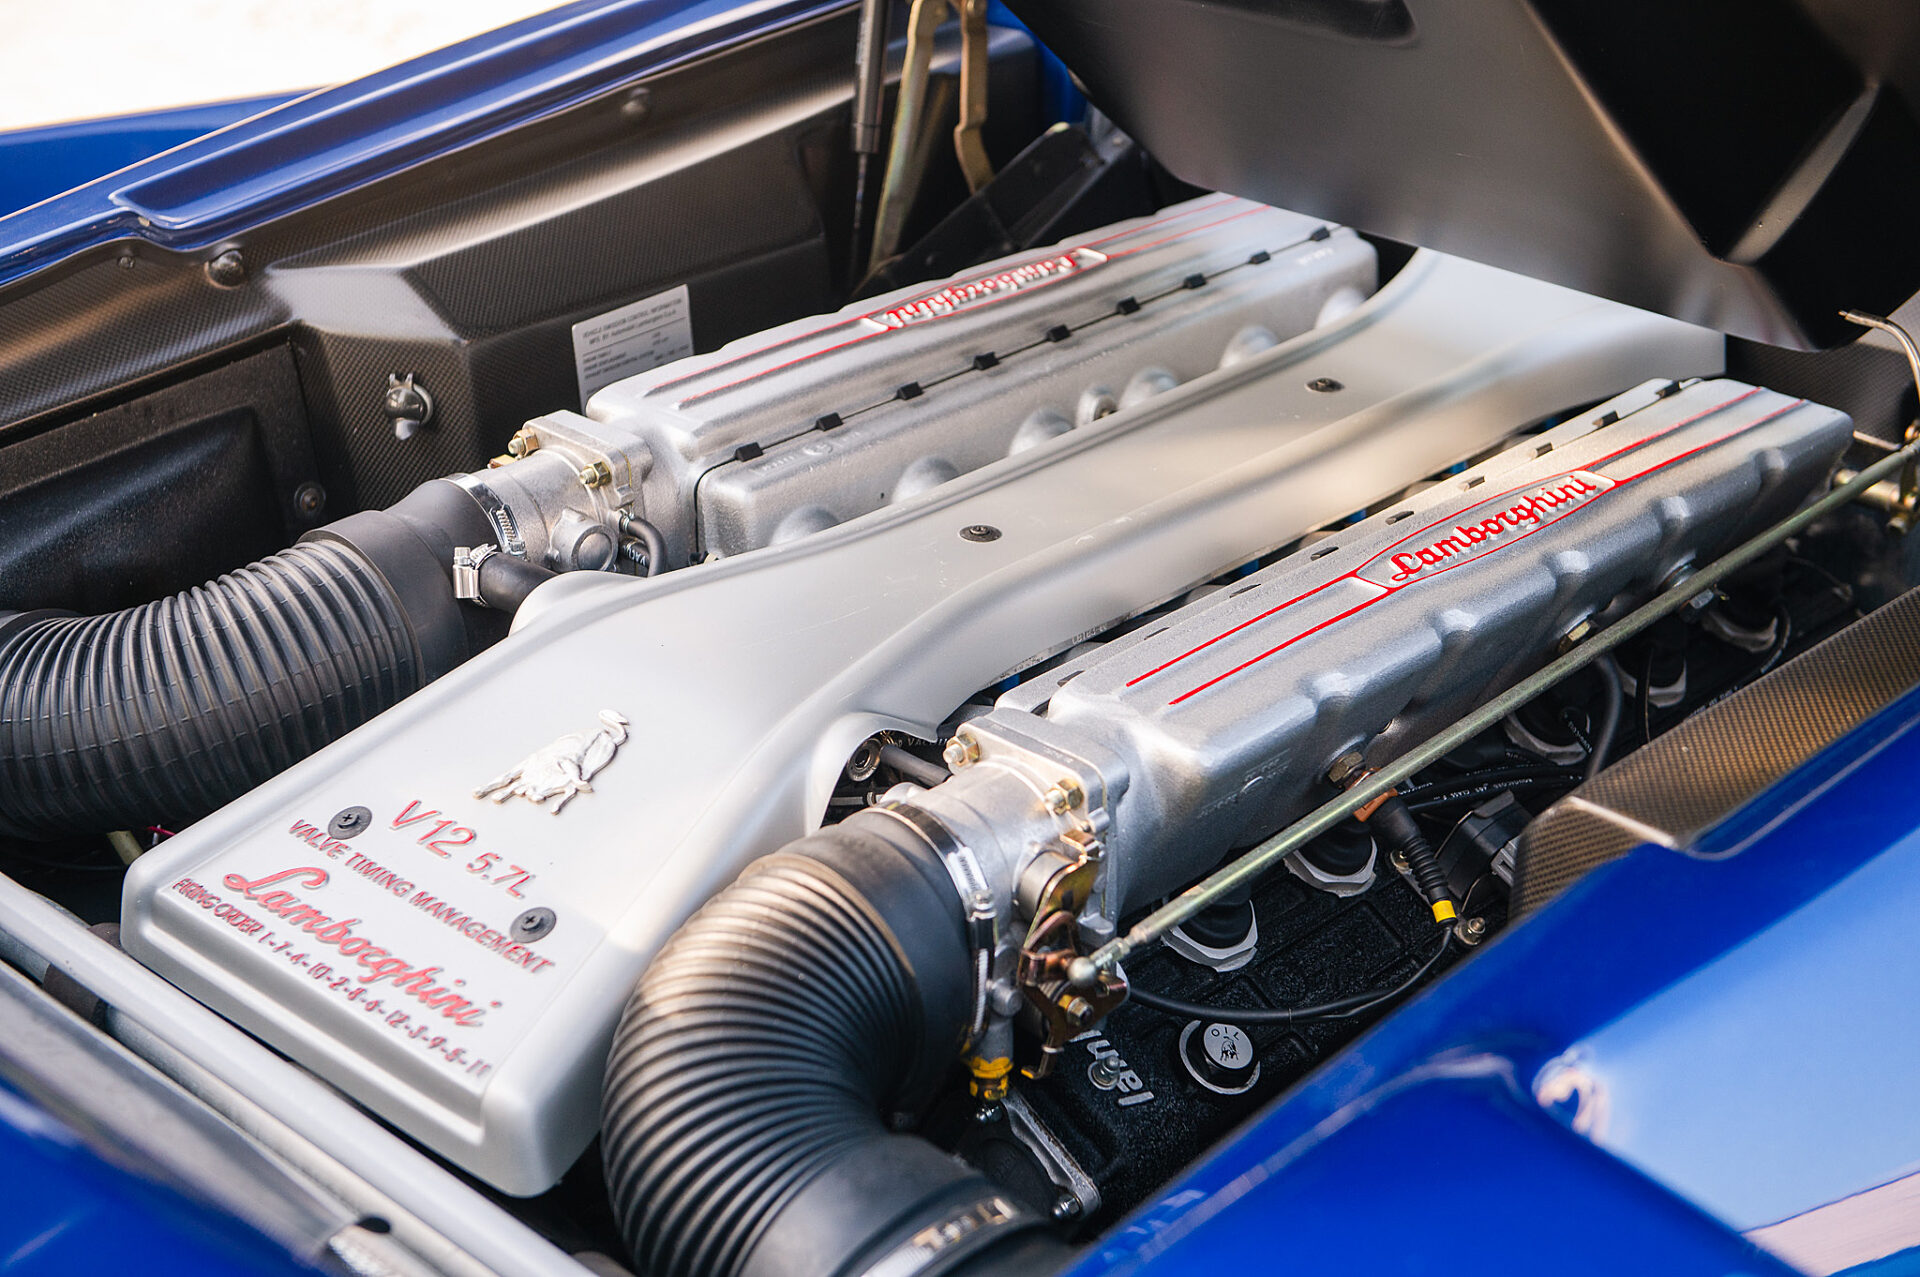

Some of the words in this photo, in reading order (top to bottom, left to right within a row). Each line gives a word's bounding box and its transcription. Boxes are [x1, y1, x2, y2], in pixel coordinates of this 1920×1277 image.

[1391, 475, 1598, 583] Lamborghini
[289, 819, 349, 861] VALVE
[345, 852, 418, 899] TIMING
[409, 890, 554, 973] MANAGEMENT
[390, 800, 476, 857] V12
[466, 852, 537, 899] 5.7L
[172, 877, 221, 909] FIRING
[213, 901, 265, 941] ORDER
[222, 866, 503, 1028] Lamborghini
[1210, 1026, 1239, 1041] OIL
